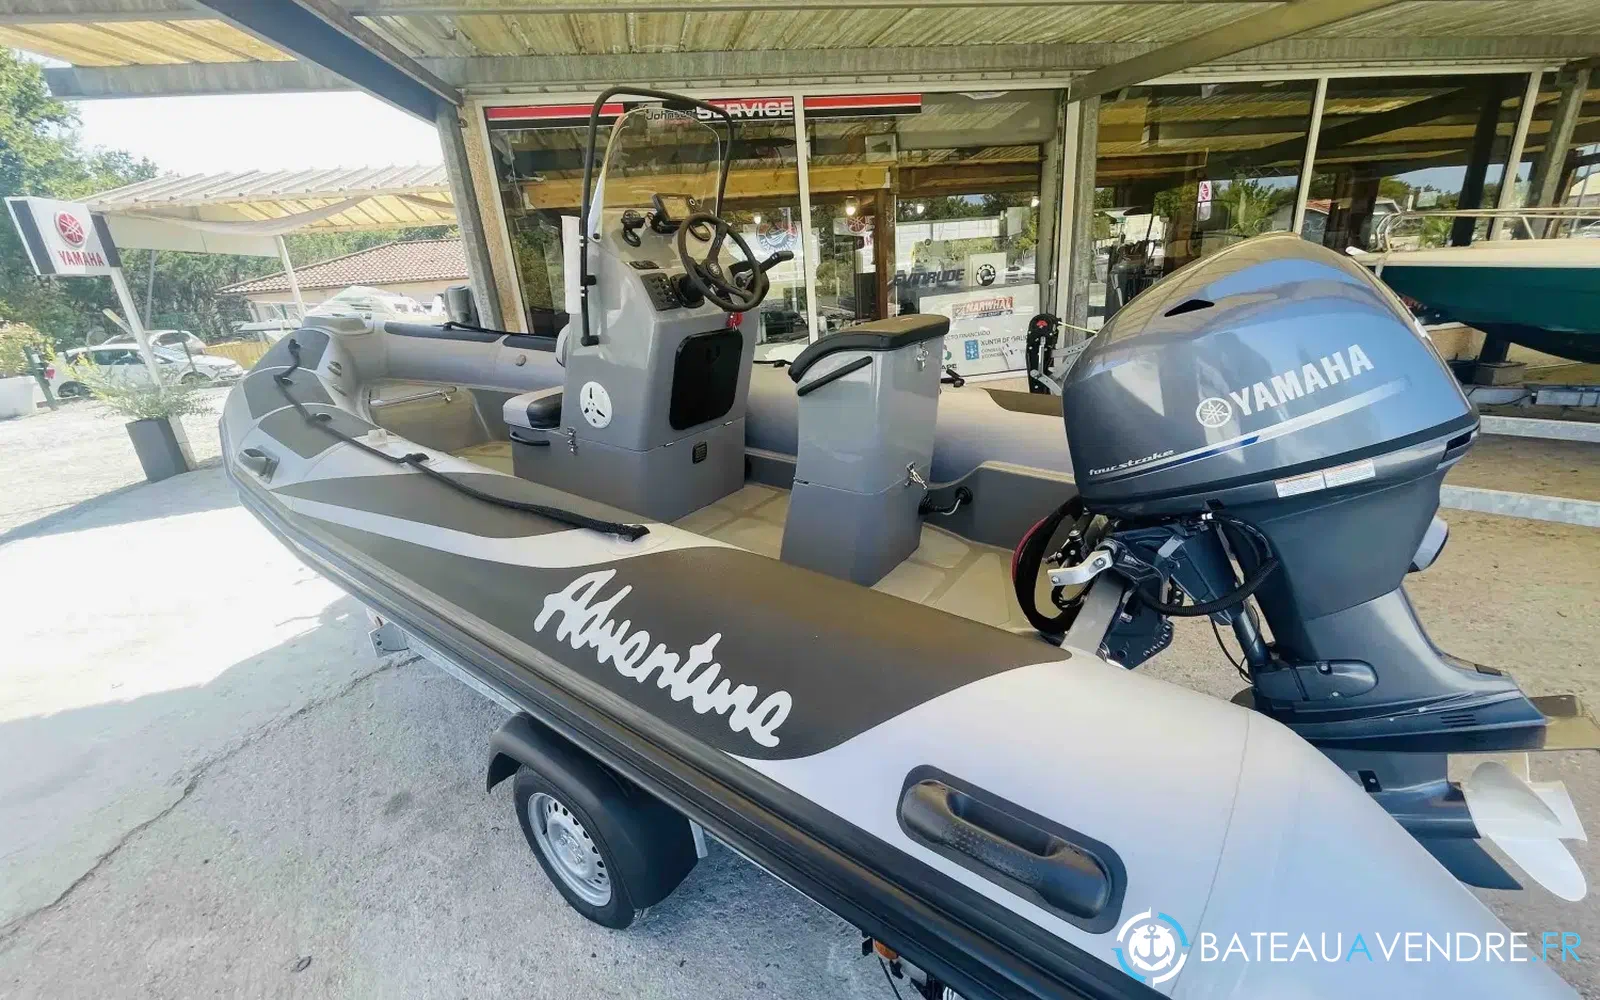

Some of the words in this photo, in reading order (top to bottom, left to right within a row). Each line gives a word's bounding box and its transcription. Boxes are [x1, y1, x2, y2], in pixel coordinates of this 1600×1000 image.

[58, 251, 105, 267] YAMAHA
[981, 338, 1001, 346] XUNTA
[1229, 344, 1375, 416] YAMAHA
[534, 569, 793, 747] Adventure
